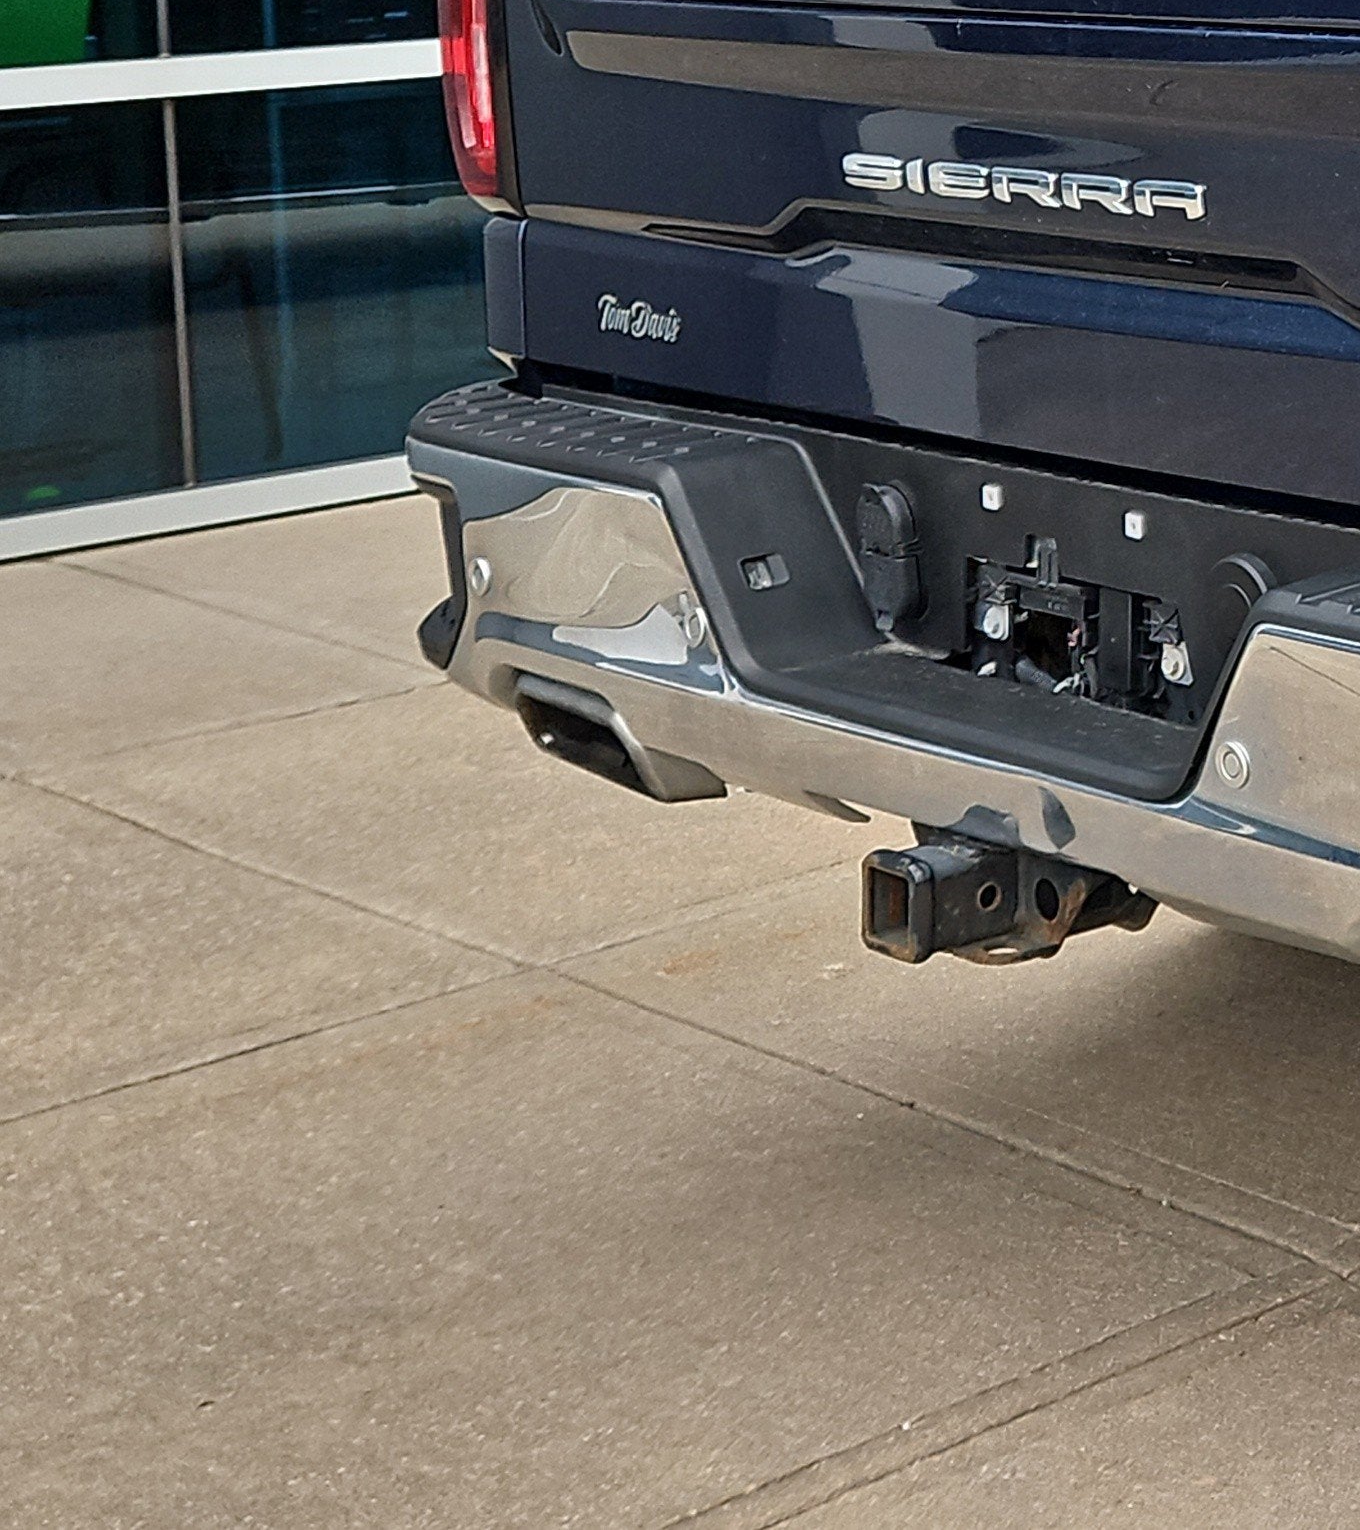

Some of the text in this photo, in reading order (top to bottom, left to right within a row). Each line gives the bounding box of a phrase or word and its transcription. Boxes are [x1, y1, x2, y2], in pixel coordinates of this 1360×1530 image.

[841, 151, 1207, 222] SIERRA
[598, 294, 682, 343] Tom Davis
